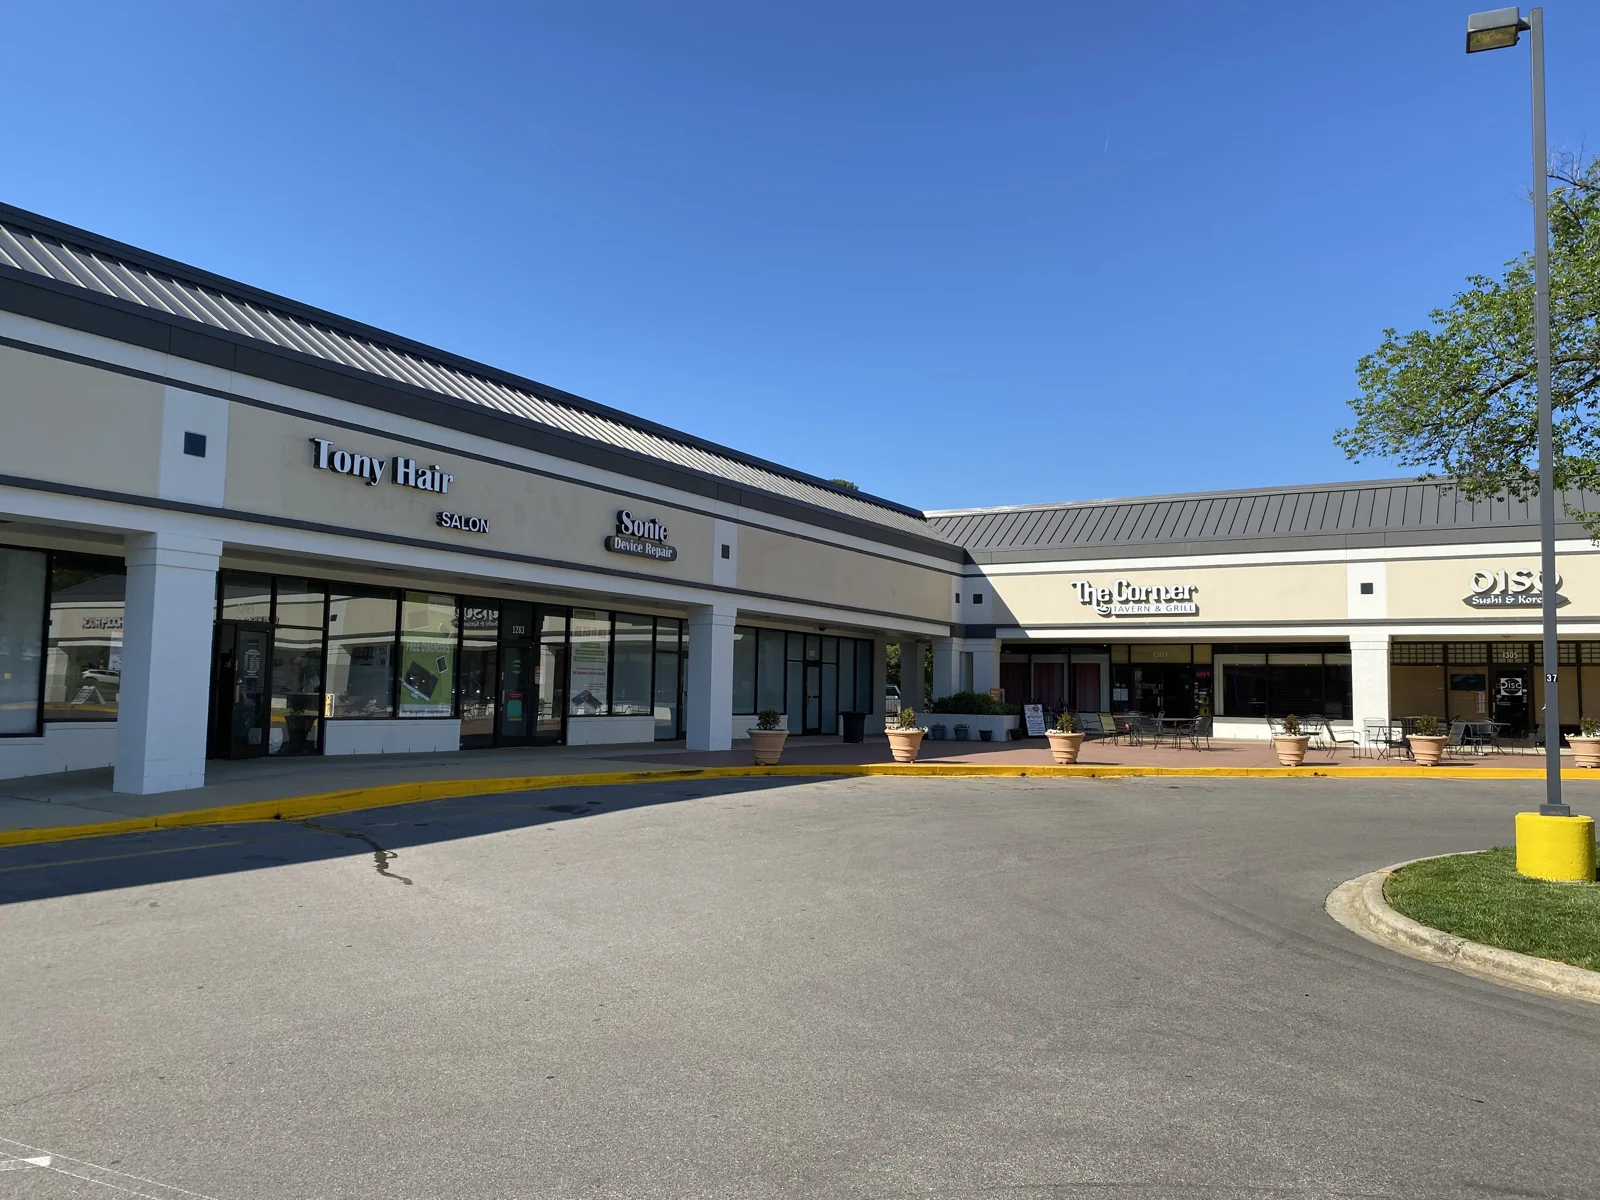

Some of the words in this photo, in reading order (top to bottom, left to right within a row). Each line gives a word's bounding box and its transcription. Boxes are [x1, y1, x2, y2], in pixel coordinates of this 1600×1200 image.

[310, 438, 386, 486] Tony
[392, 457, 454, 494] Hair
[438, 511, 489, 533] SALON
[614, 537, 643, 553] Device
[645, 542, 673, 558] Repair
[1070, 580, 1110, 614] The
[1113, 579, 1195, 602] Corner
[1472, 595, 1502, 605] Sushi
[1505, 595, 1515, 604] &
[1113, 605, 1150, 613] TAVERN
[1165, 604, 1194, 612] GRILL
[512, 625, 525, 634] 1283
[1502, 651, 1518, 659] 1305
[1546, 673, 1558, 682] 37
